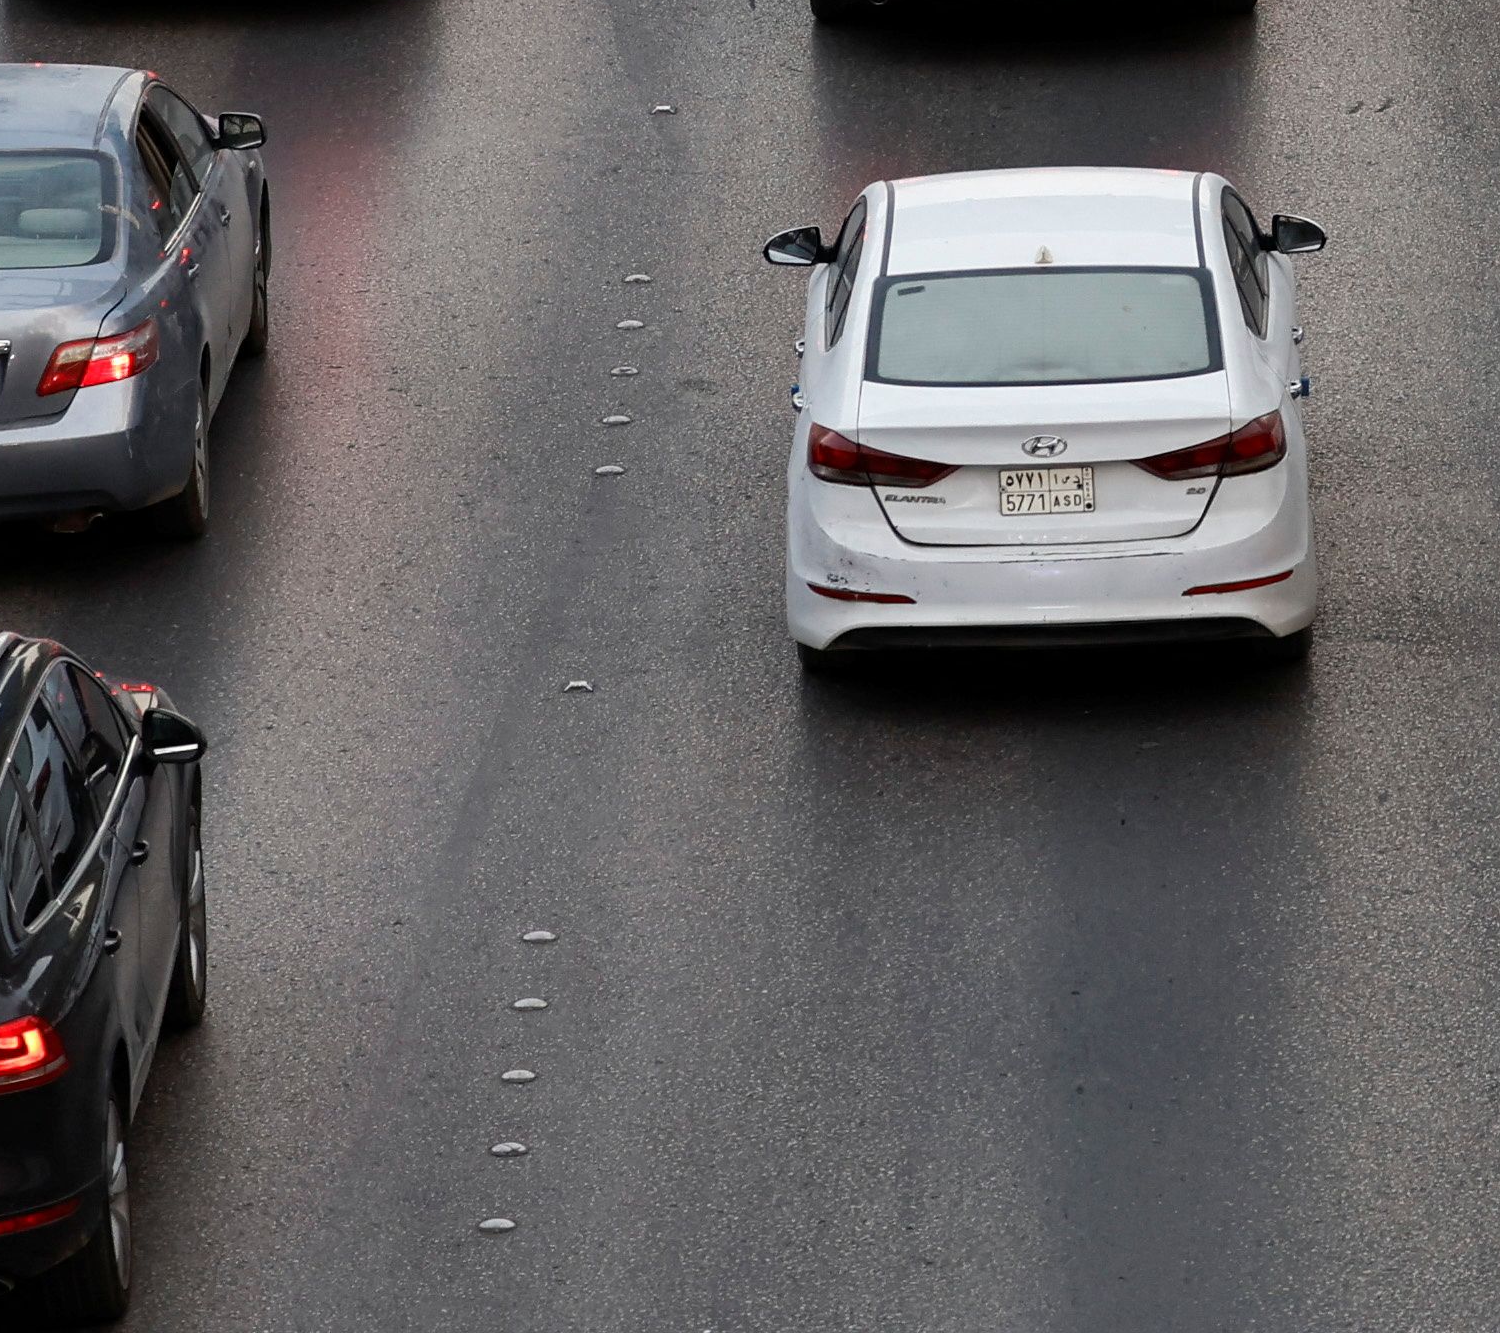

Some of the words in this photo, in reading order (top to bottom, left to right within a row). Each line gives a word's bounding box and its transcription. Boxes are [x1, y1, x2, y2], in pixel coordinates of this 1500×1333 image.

[1005, 474, 1044, 489] ٥٧٧١
[884, 493, 947, 505] ELANTRA
[1006, 493, 1046, 512] 5771
[1053, 494, 1082, 508] ASD
